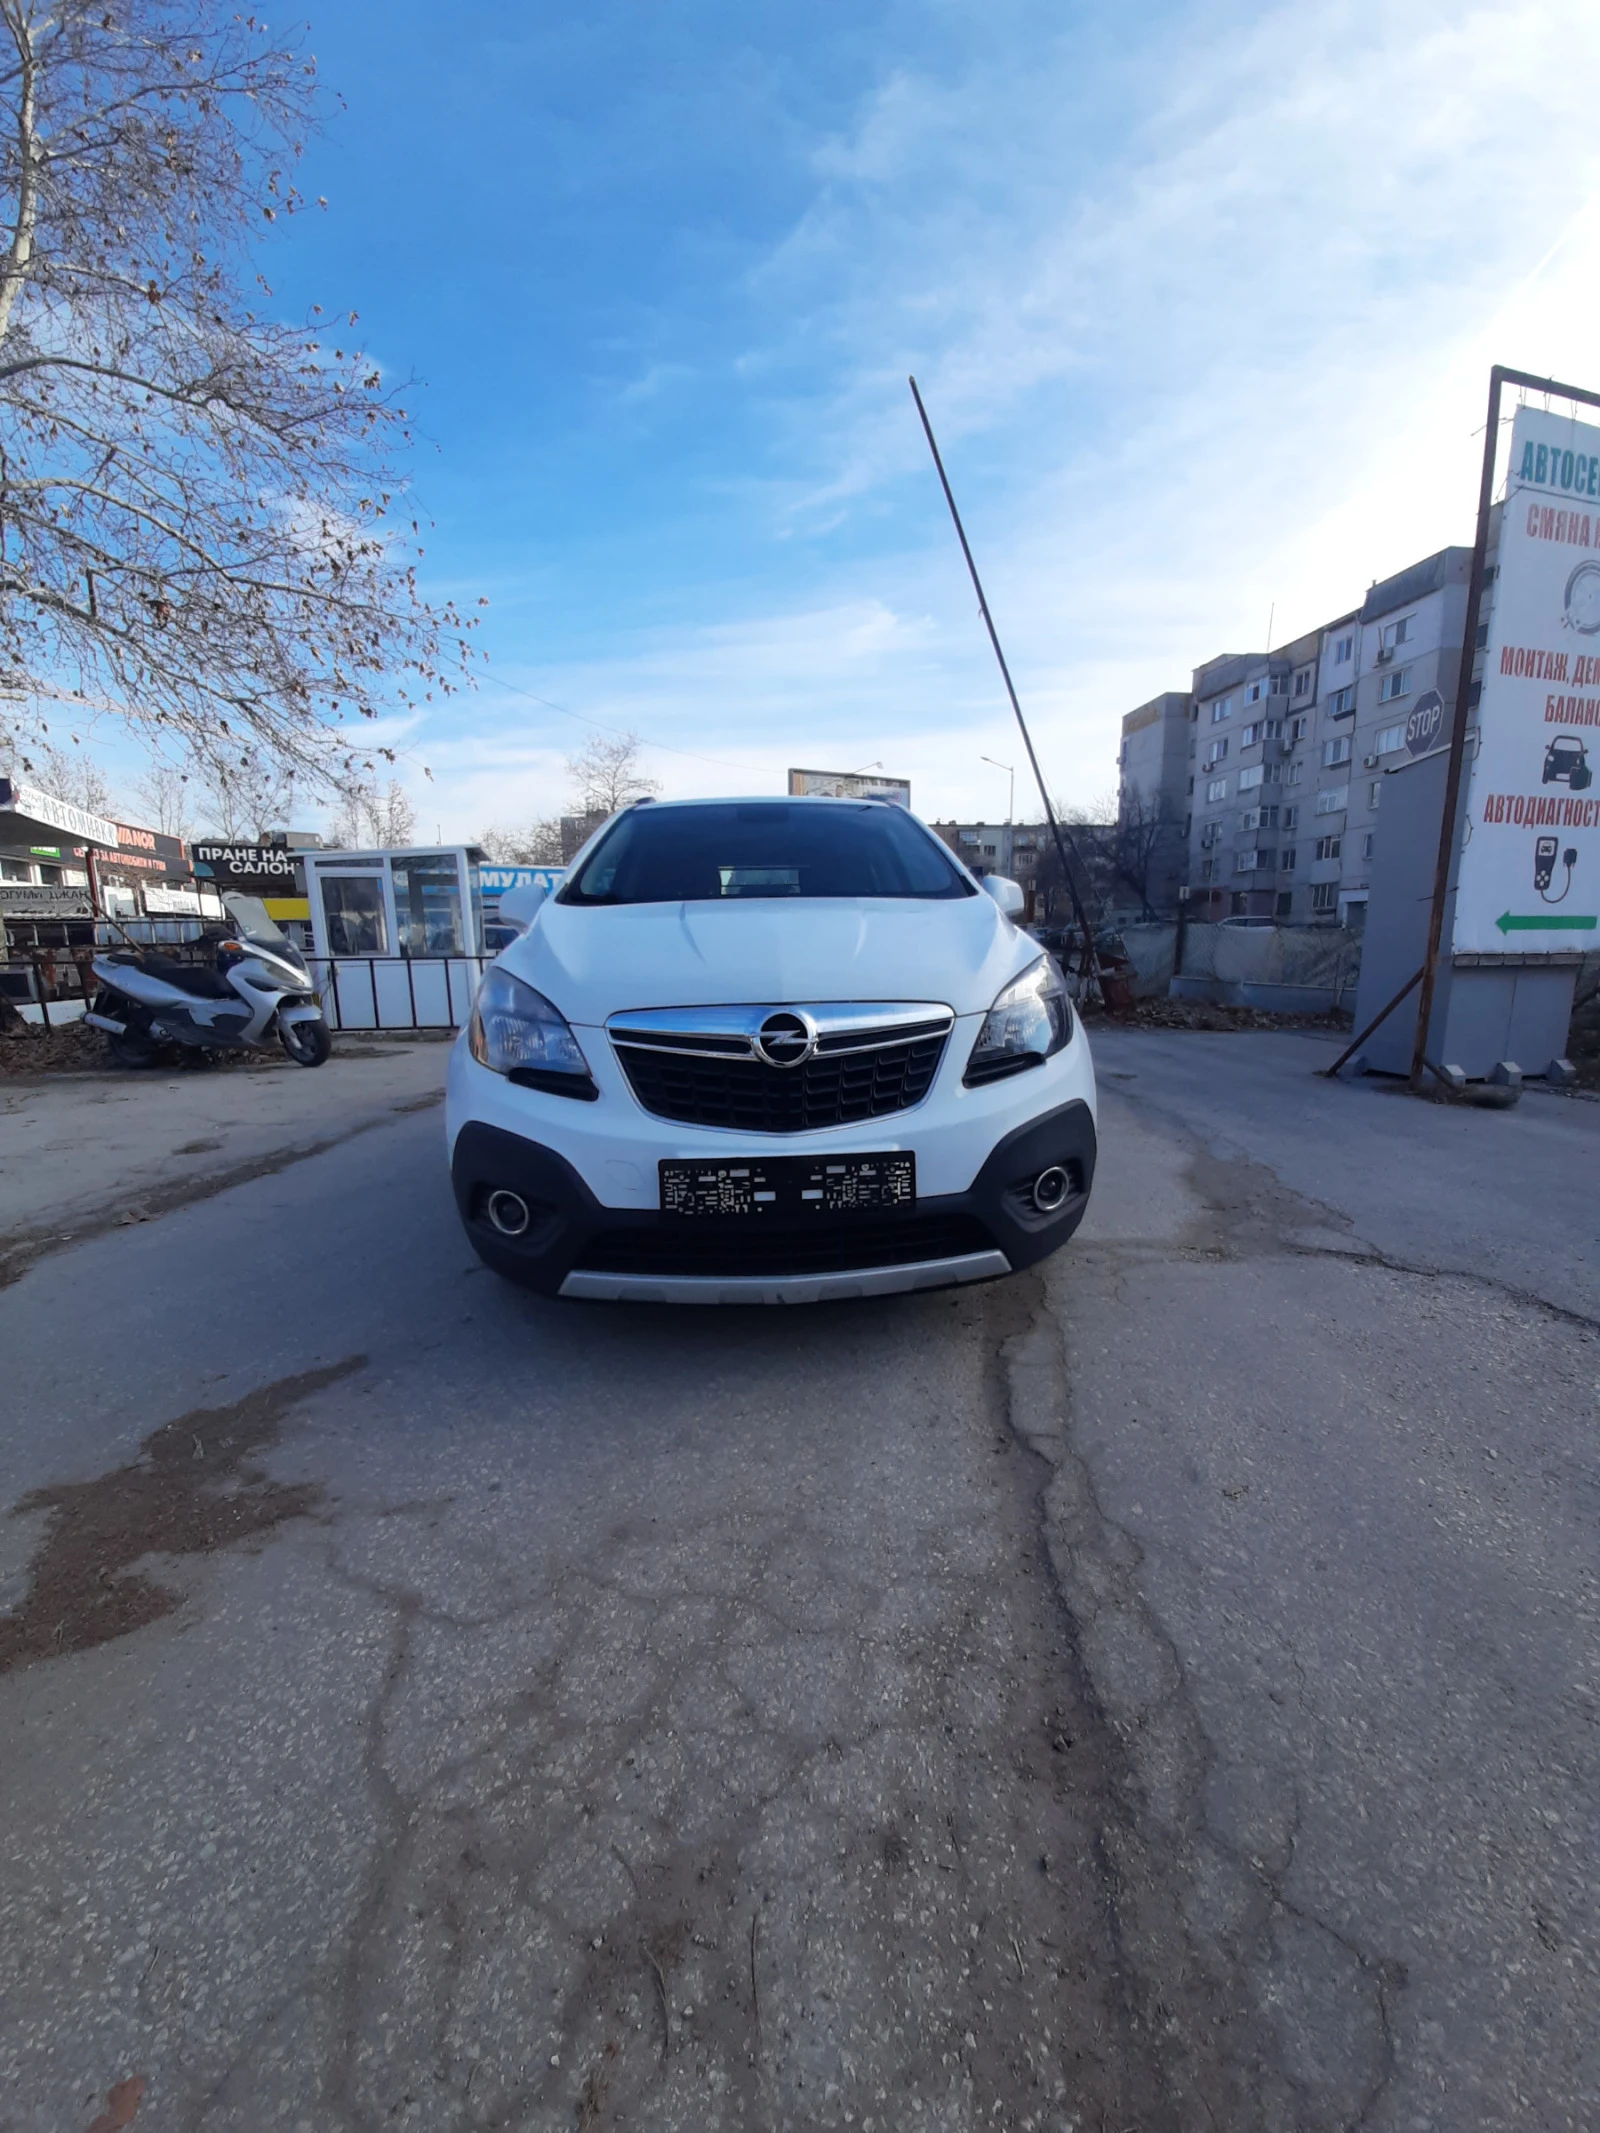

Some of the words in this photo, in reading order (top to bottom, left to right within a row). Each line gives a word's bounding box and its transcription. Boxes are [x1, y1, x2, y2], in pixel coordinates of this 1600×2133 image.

[1520, 440, 1600, 497] АВТОСЕ
[1526, 502, 1590, 548] СМЯНА
[1407, 704, 1440, 741] STOP
[42, 796, 116, 846] АВТОМИВКА
[198, 847, 258, 862] ПРАНЕ
[262, 849, 287, 863] НА
[229, 861, 299, 875] САЛОН
